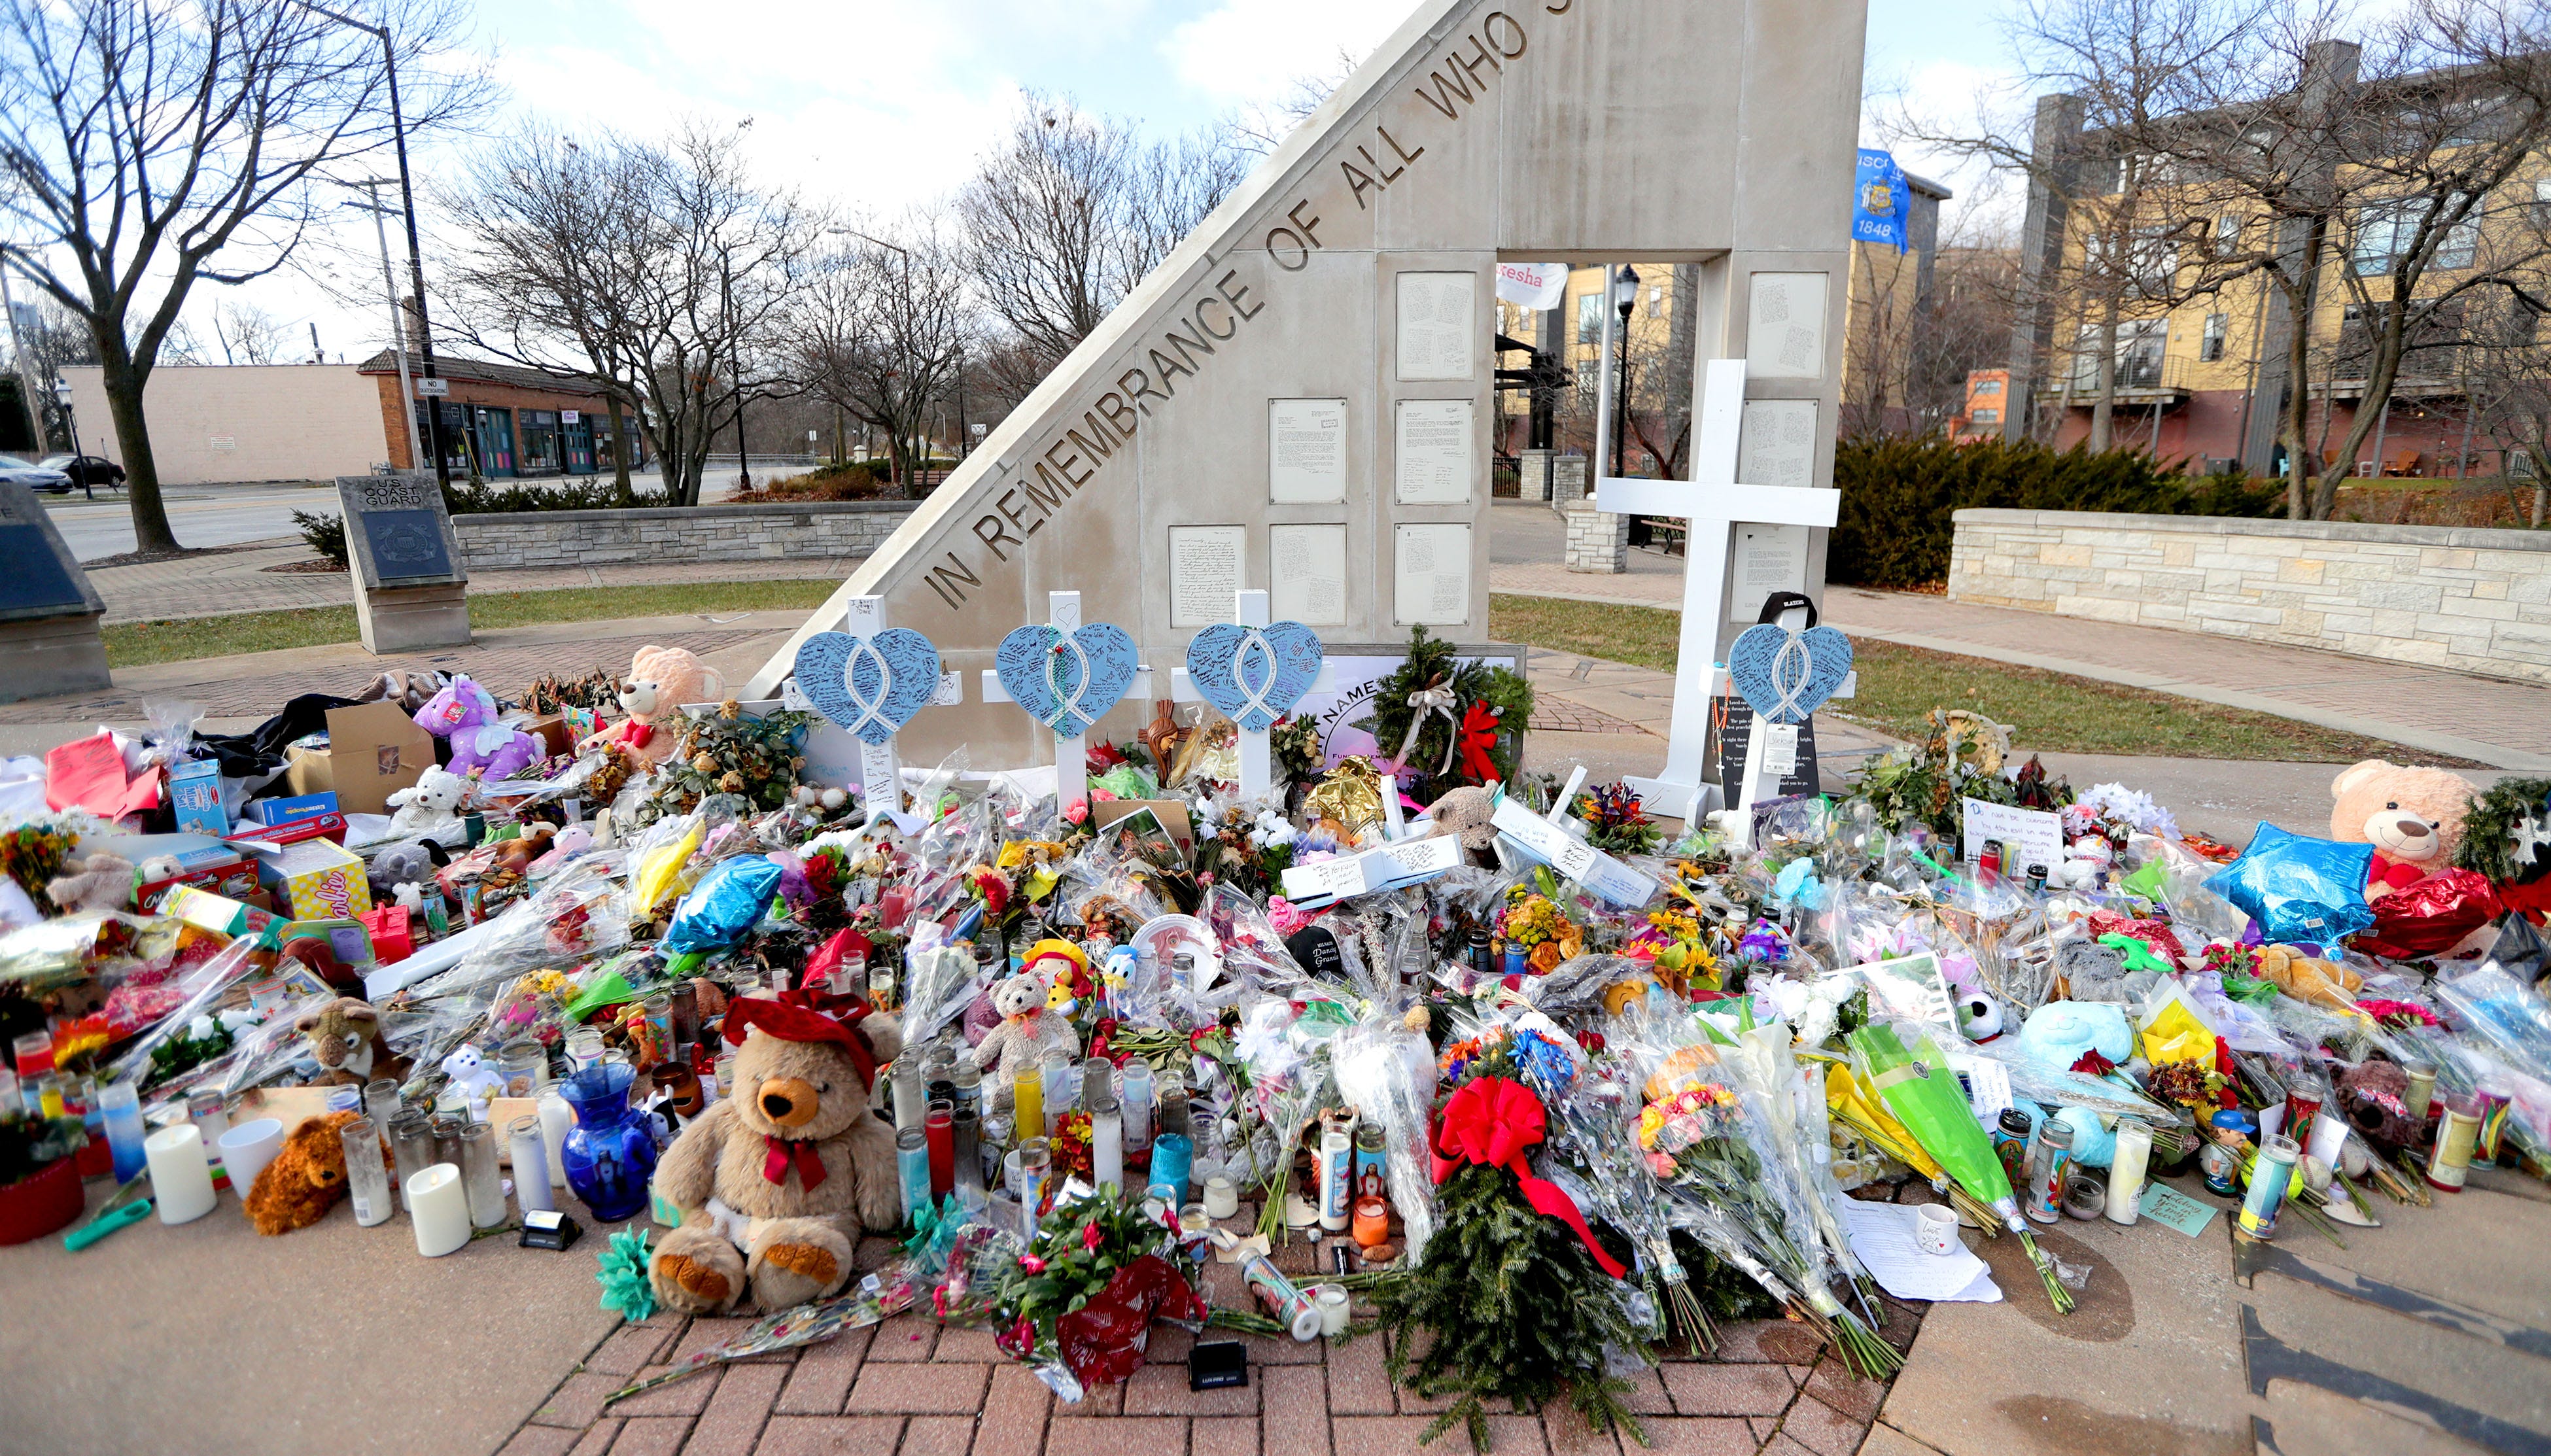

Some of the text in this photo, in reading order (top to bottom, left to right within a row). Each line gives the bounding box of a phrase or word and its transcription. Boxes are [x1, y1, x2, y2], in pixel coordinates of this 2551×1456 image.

[1859, 220, 1892, 237] 1848
[924, 551, 982, 611] IN
[973, 269, 1266, 562] REMEMBRANCE
[1266, 198, 1323, 271] OF
[1341, 126, 1425, 211] ALL
[1415, 11, 1527, 122] WHO
[364, 487, 417, 497] COAST
[365, 495, 422, 506] GUARD
[1323, 680, 1378, 724] NAME
[176, 794, 187, 807] Set
[184, 786, 198, 810] Mixer
[1970, 802, 1984, 816] Do
[265, 829, 284, 837] with
[284, 822, 315, 832] Thomas
[1981, 821, 1992, 832] by
[1995, 825, 2009, 833] the
[185, 873, 219, 888] Doodle
[2155, 1198, 2194, 1217] you in
[2160, 1192, 2202, 1215] Holding
[2147, 1207, 2187, 1226] heart
[1922, 1220, 1942, 1234] Love
